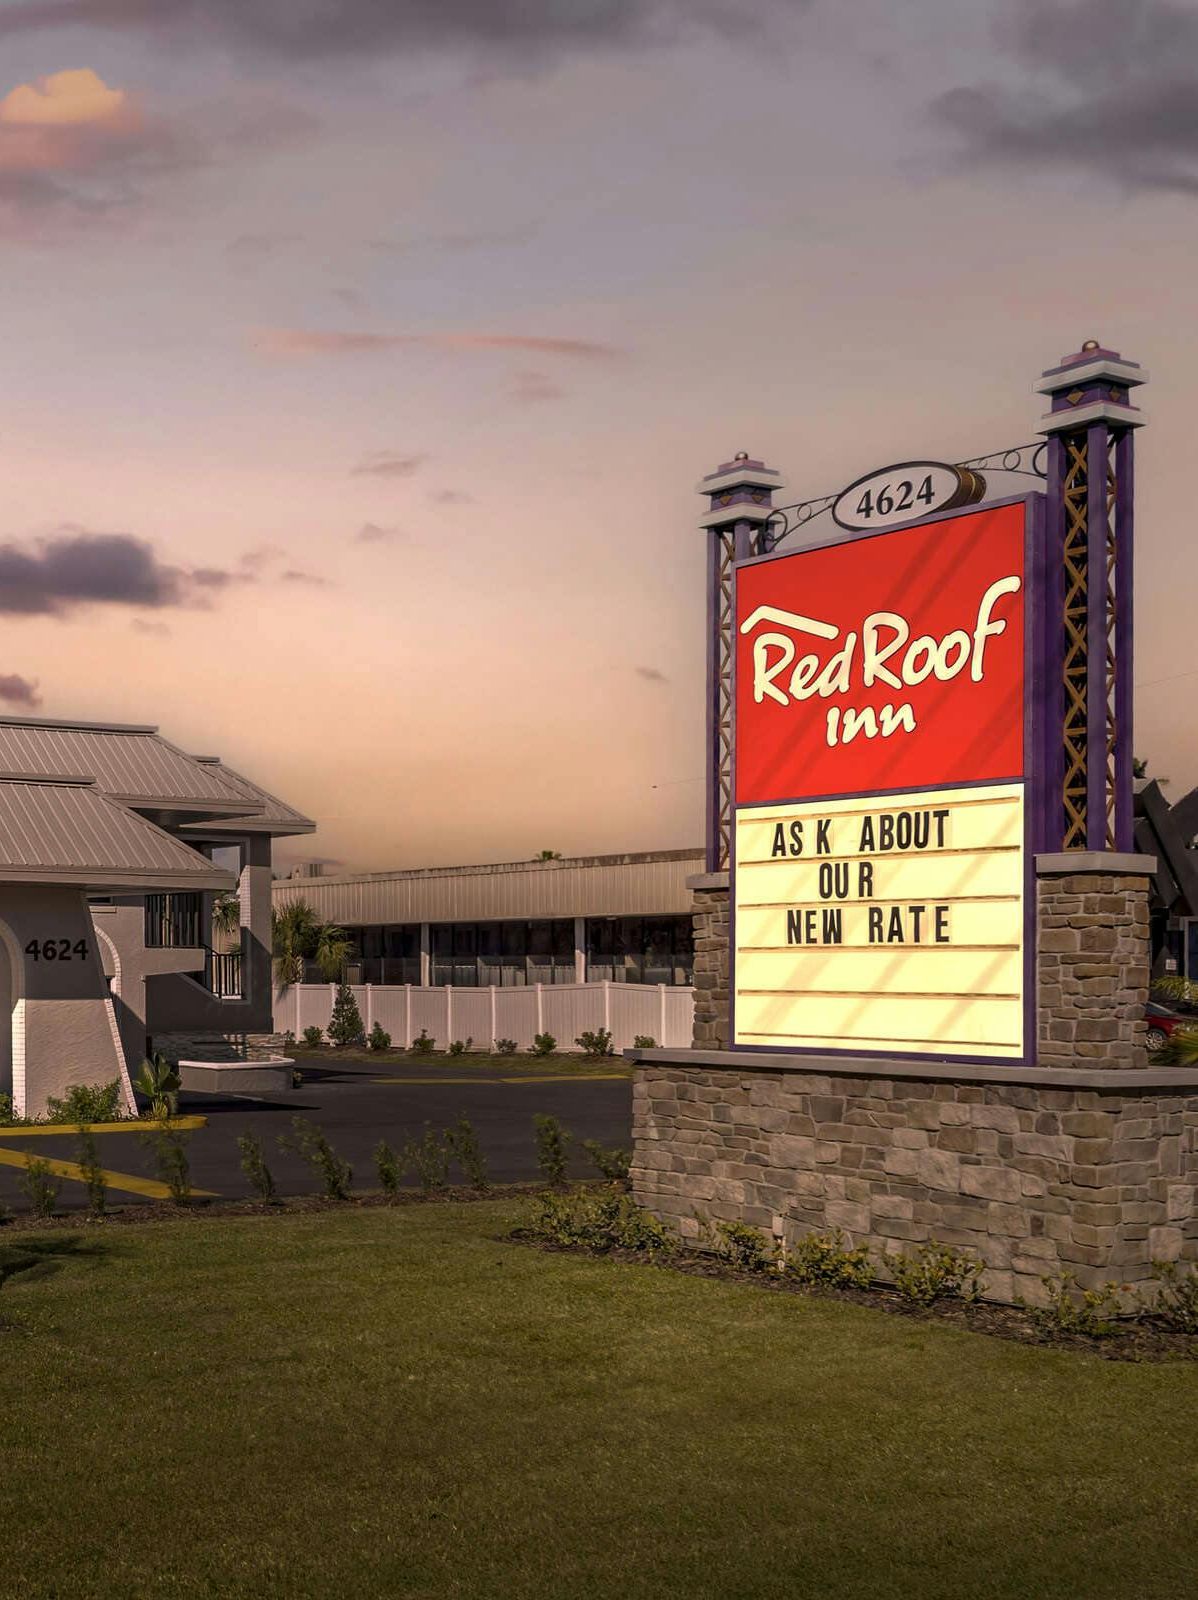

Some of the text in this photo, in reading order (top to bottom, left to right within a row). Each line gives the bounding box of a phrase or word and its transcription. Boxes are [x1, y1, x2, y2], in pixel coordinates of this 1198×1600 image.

[855, 474, 936, 519] 4624
[753, 575, 1021, 706] Red Roof
[858, 810, 950, 852] ABOUT
[786, 905, 950, 945] NEW RATE
[24, 938, 90, 962] 4624
